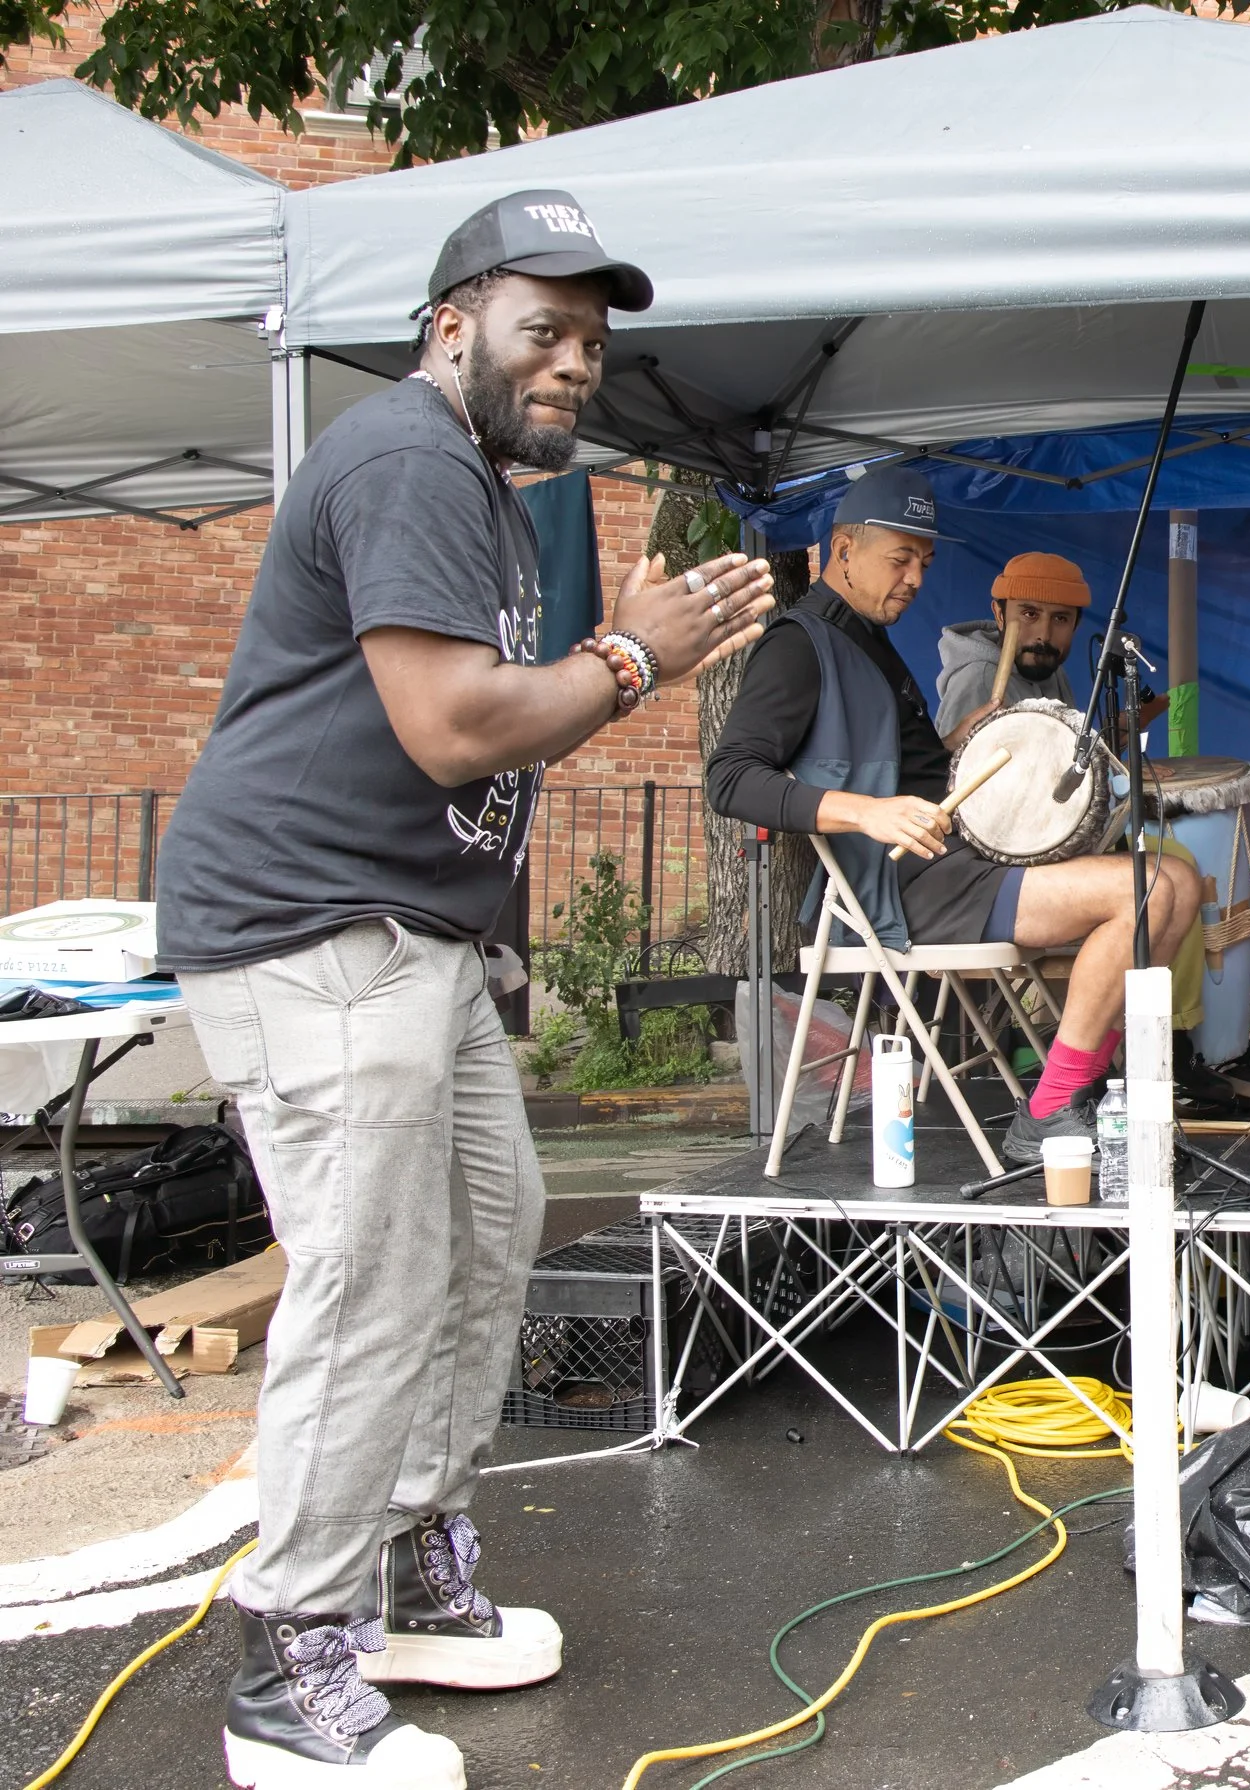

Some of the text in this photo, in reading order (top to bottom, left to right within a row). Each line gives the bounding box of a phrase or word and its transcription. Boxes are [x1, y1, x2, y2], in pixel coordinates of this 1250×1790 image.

[524, 204, 579, 220] THEY
[546, 217, 592, 237] LIKE
[28, 962, 68, 972] PIZZA
